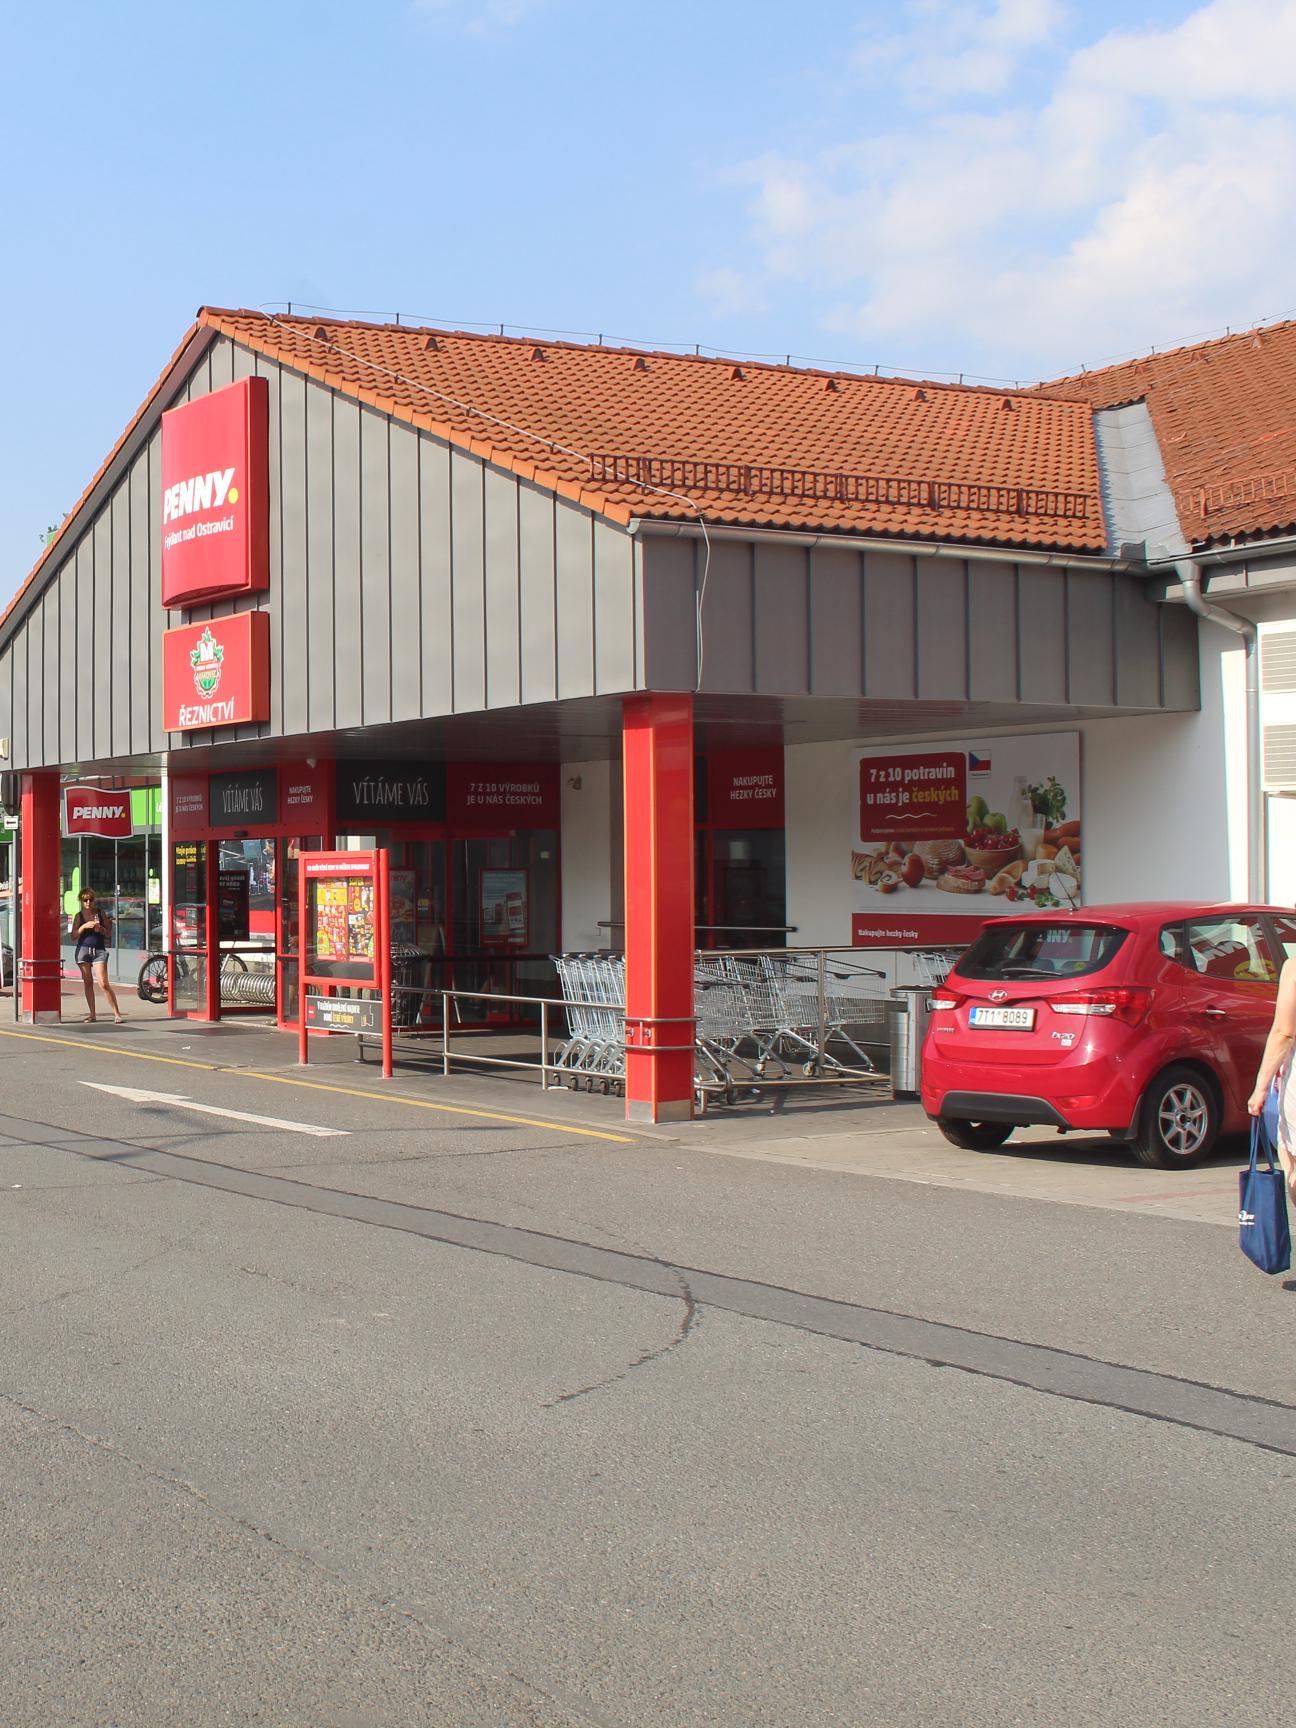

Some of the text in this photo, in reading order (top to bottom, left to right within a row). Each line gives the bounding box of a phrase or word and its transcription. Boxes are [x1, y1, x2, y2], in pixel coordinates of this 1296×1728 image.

[178, 695, 235, 726] ŘEZNICTVÍ
[733, 774, 774, 787] NAKUPUJTE
[870, 762, 955, 783] 7 z 10 potravin
[222, 781, 263, 813] VÍTÁME VÁS
[352, 776, 429, 805] VÍTÁME VÁS
[730, 789, 753, 800] HEZKY
[867, 786, 959, 806] u nás je českých
[858, 929, 919, 939] Nakupujte hezky česky
[977, 1009, 1028, 1024] 7T1 8089
